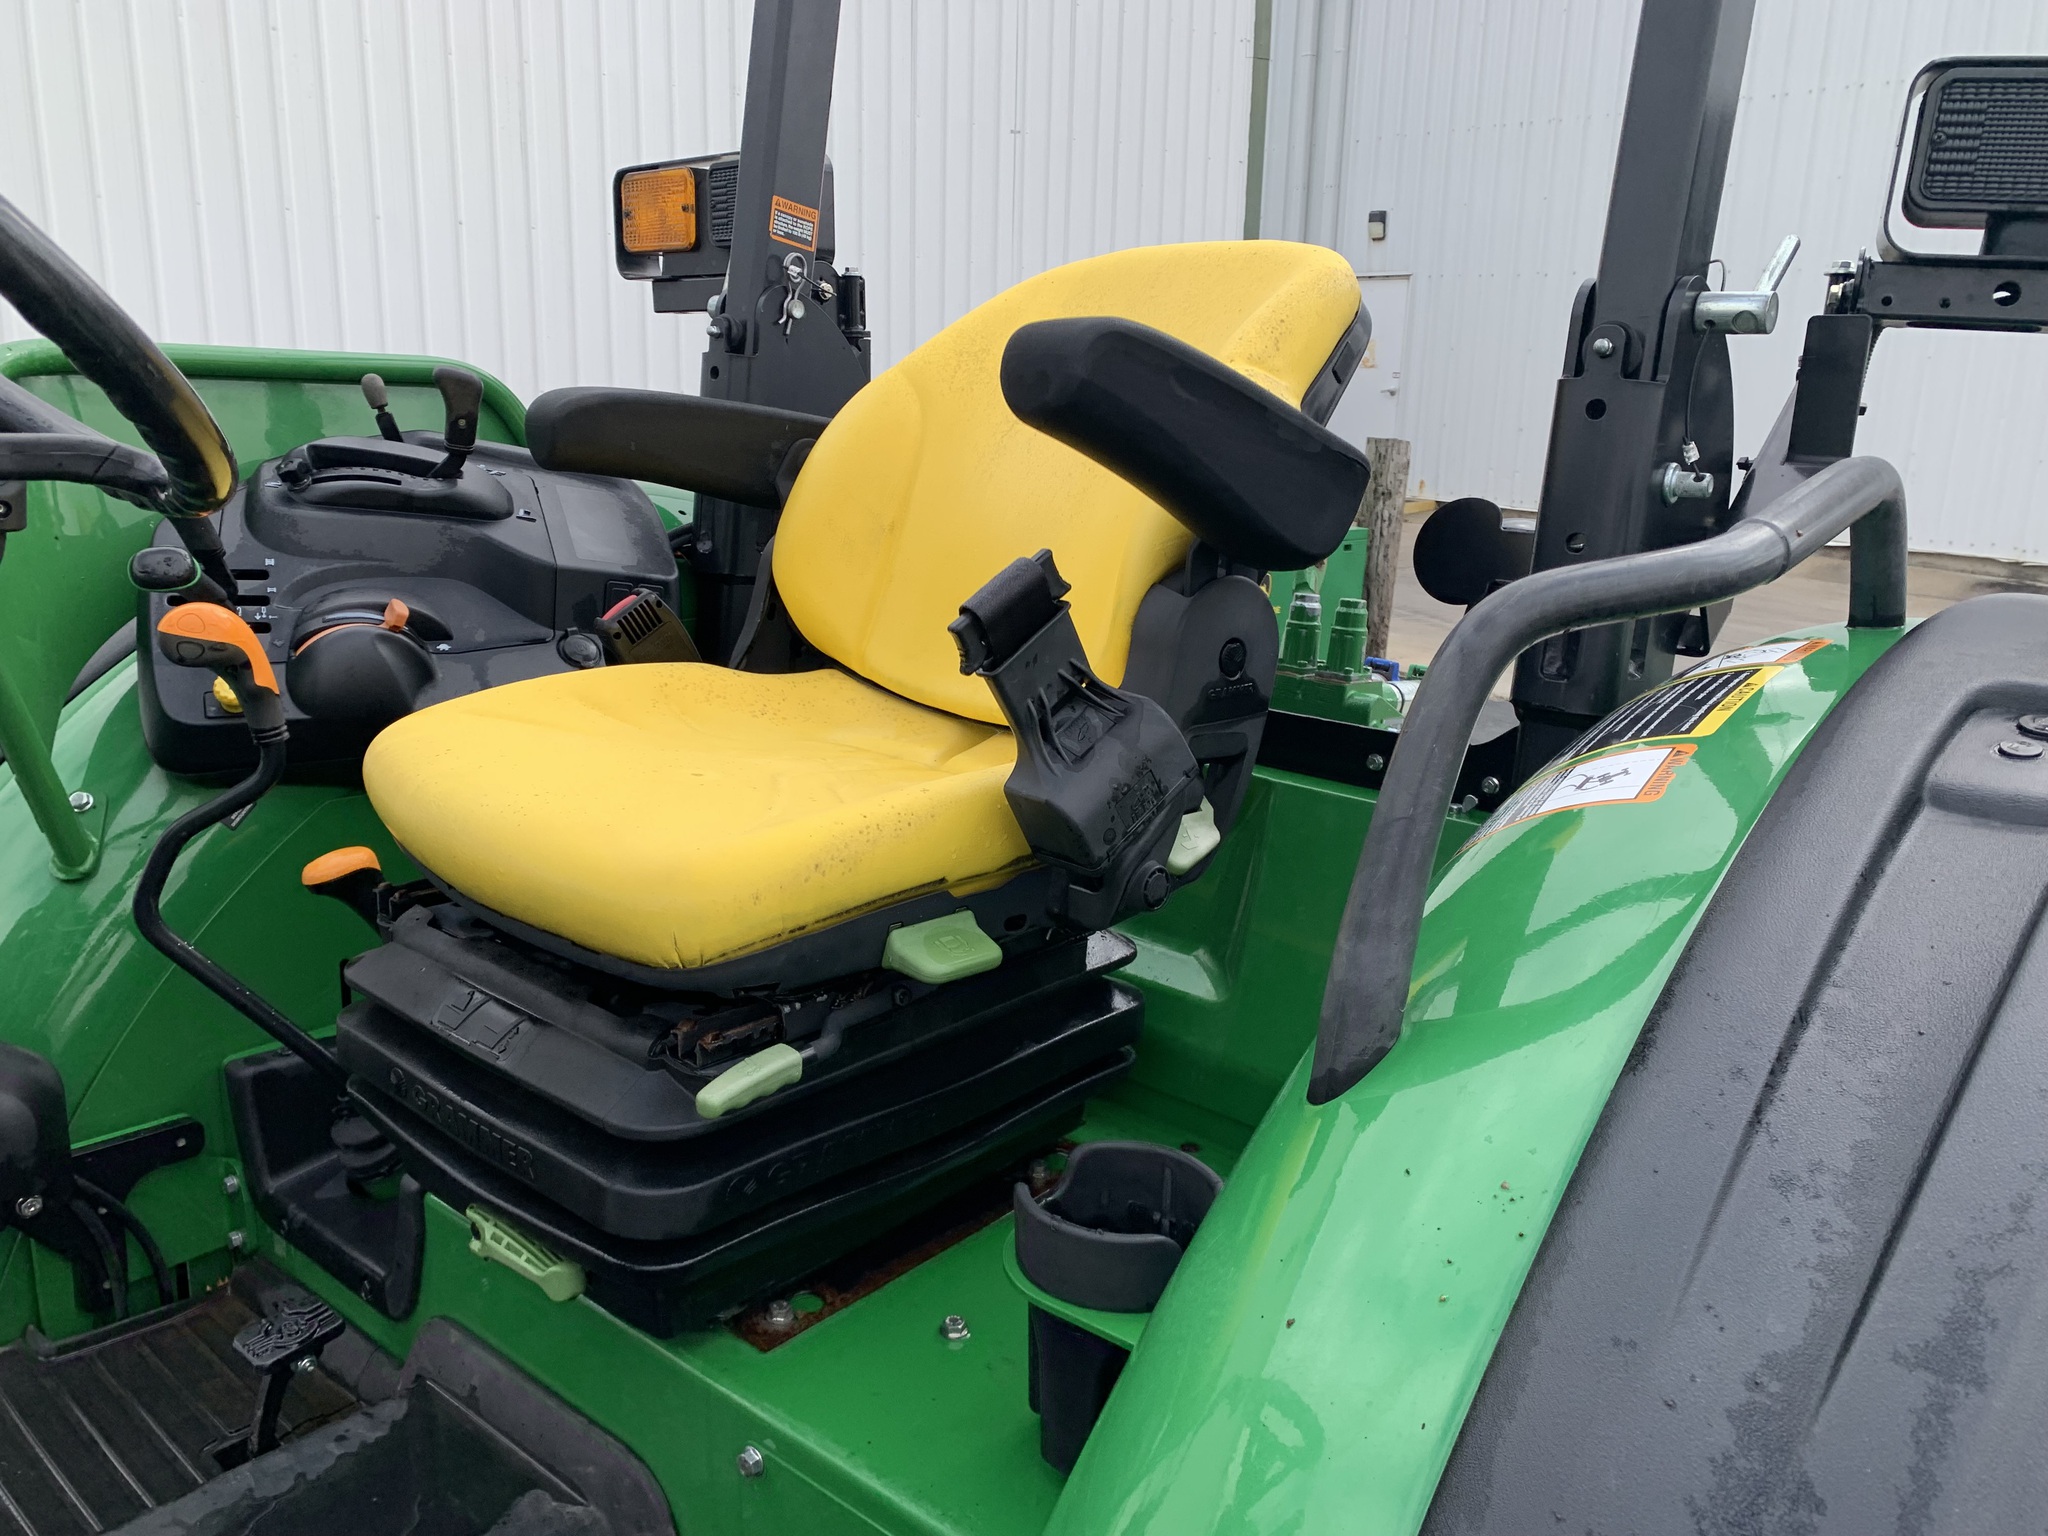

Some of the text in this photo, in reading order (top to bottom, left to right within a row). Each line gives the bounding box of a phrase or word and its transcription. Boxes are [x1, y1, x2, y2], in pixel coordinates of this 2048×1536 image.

[781, 200, 817, 220] WARNING
[1716, 687, 1755, 711] CAUTION
[1643, 757, 1685, 796] WARNING
